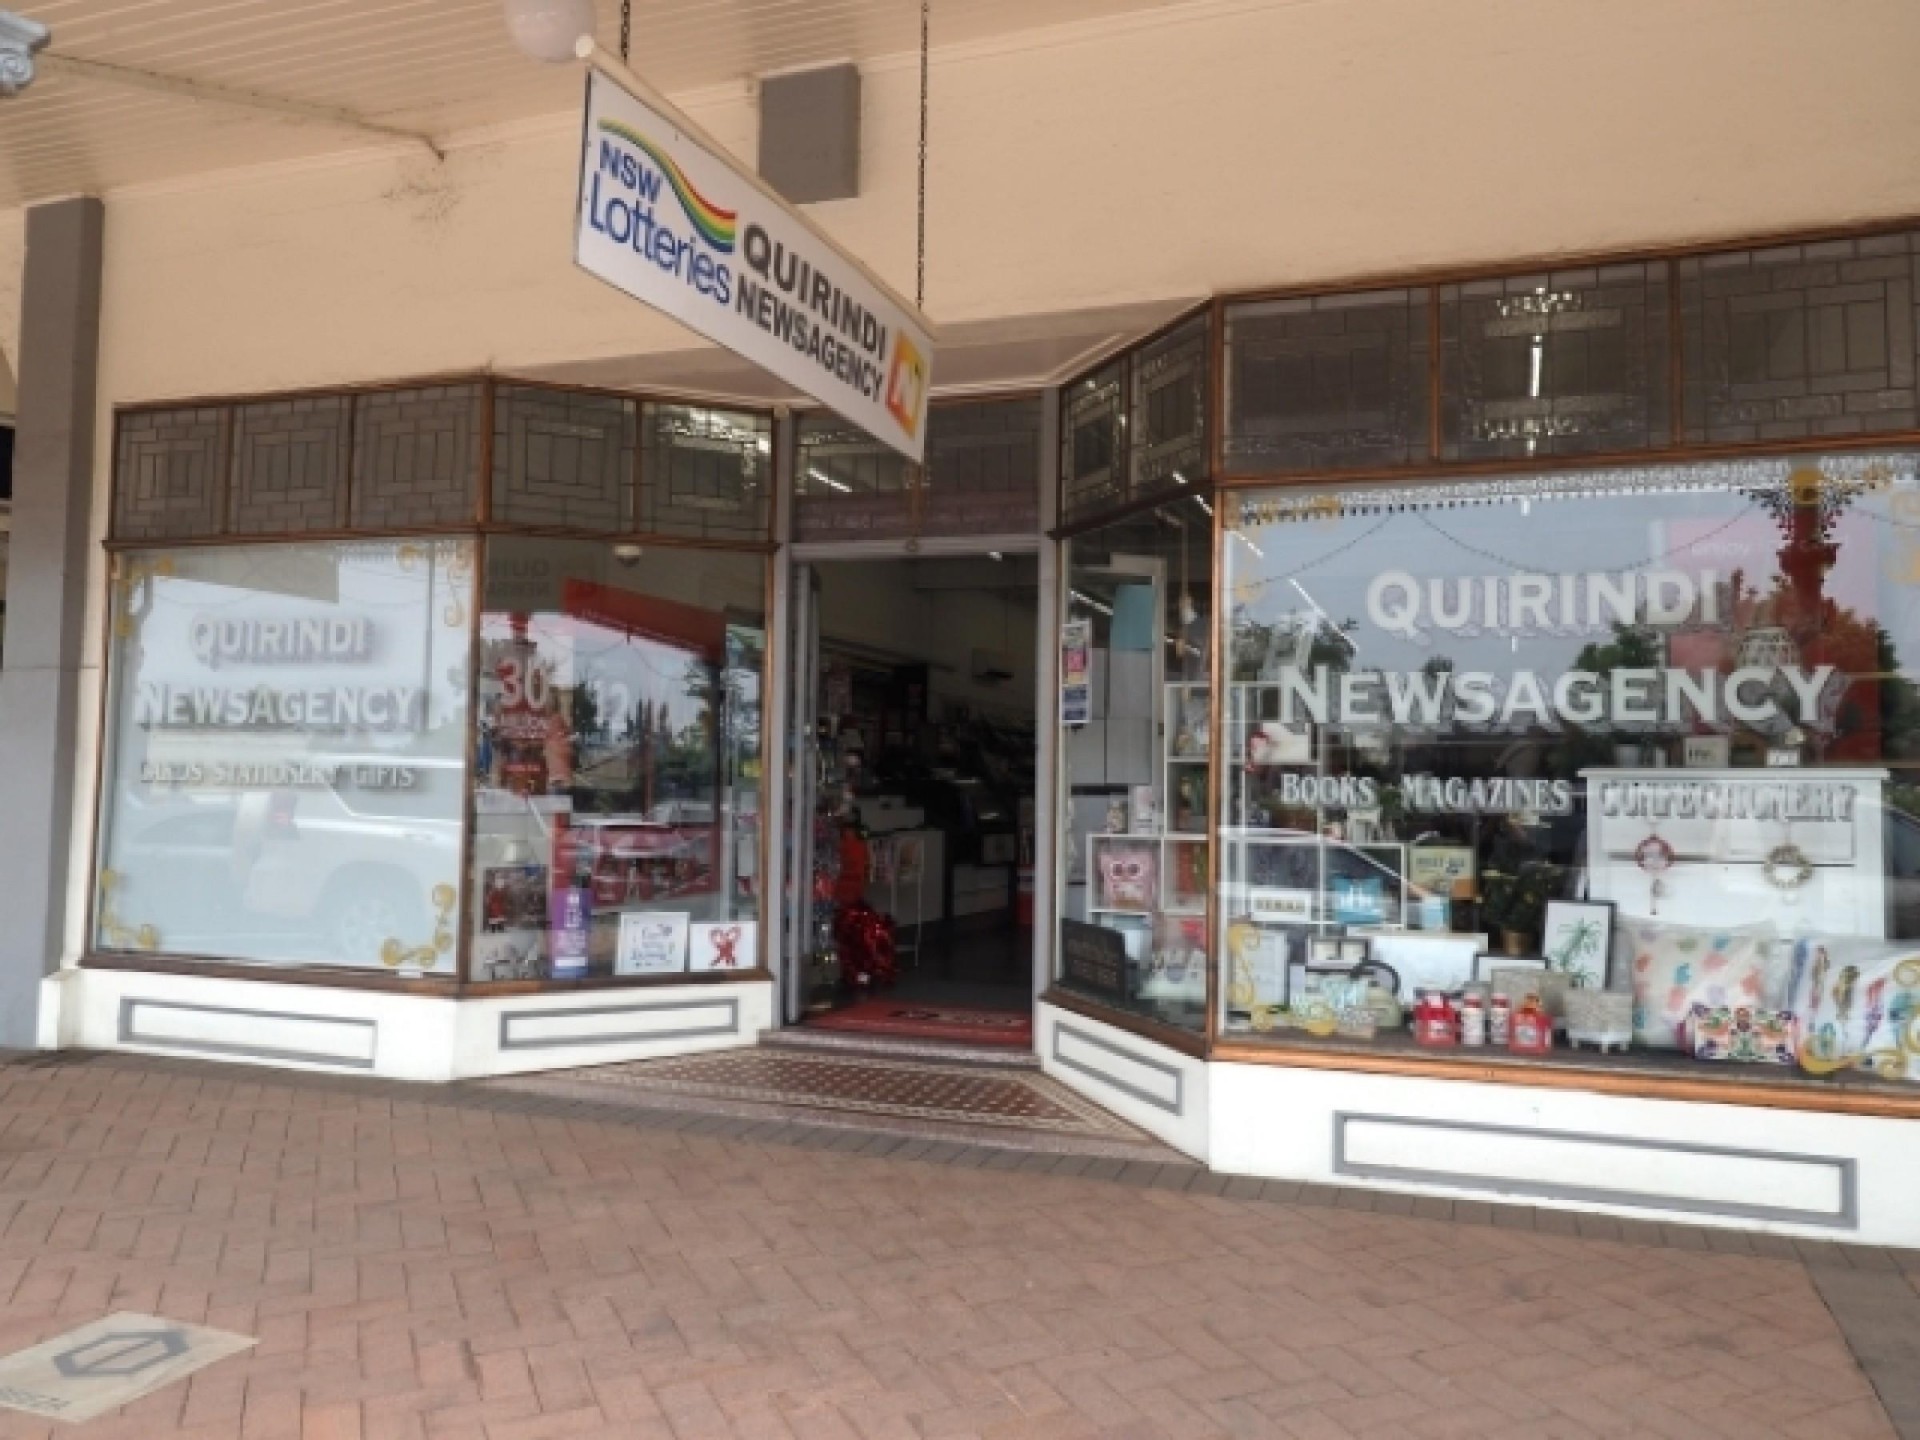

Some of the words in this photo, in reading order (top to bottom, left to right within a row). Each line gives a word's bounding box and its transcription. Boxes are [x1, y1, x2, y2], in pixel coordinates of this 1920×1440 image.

[600, 140, 662, 201] NSW
[590, 172, 731, 304] Lotteries
[743, 222, 887, 361] QUIRINDI
[736, 274, 883, 402] NEWSAGENCY
[1366, 568, 1722, 634] QUIRINDI
[193, 618, 370, 664] QUIRINDI
[139, 683, 424, 730] NEWSAGENCY
[1278, 664, 1838, 728] NEWSAGENCY
[353, 766, 418, 789] GIFTS
[1281, 773, 1377, 807] BOOKS
[1402, 773, 1573, 815] MAGAZINES
